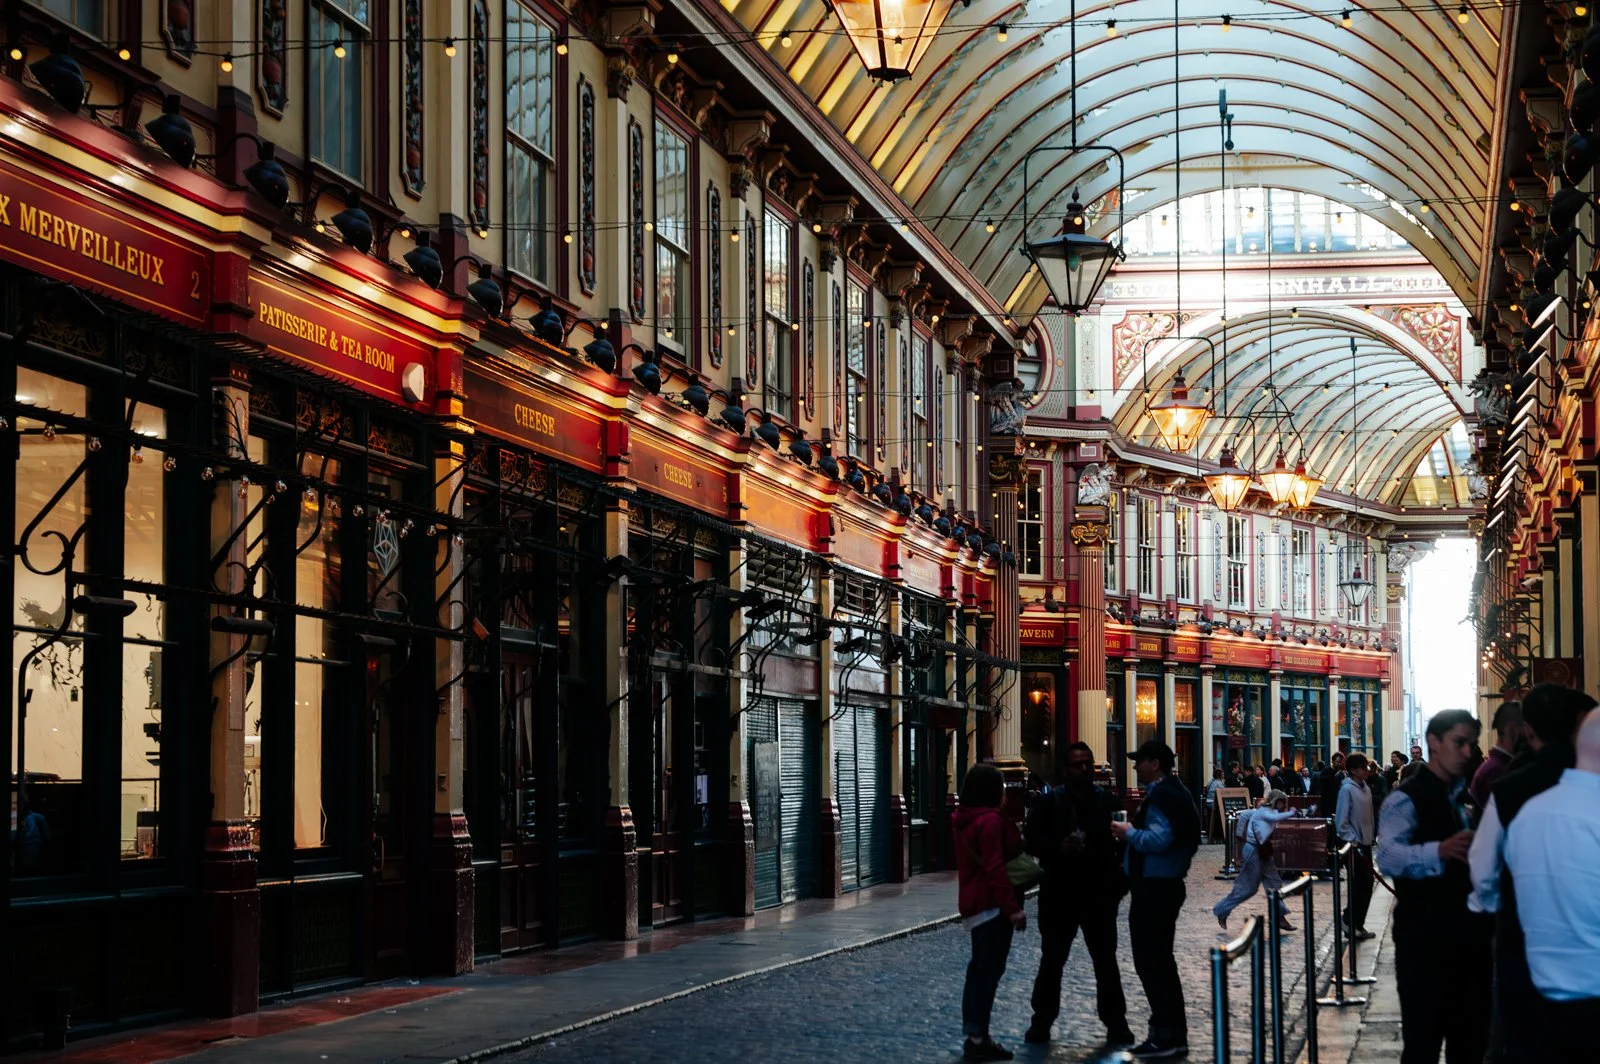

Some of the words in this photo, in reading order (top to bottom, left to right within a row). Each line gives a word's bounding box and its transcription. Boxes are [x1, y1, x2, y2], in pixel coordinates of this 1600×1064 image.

[19, 201, 165, 286] MERVEILLEUX
[191, 271, 200, 299] 2
[259, 301, 327, 347] PATISSERIE
[329, 330, 339, 351] &
[341, 335, 363, 362] TEA
[365, 344, 395, 374] ROOM
[514, 403, 555, 437] CHEESE
[663, 462, 693, 489] CHEESE
[1019, 628, 1055, 639] TAVERN
[1105, 639, 1121, 649] LAMB
[1140, 642, 1158, 652] TAVERN
